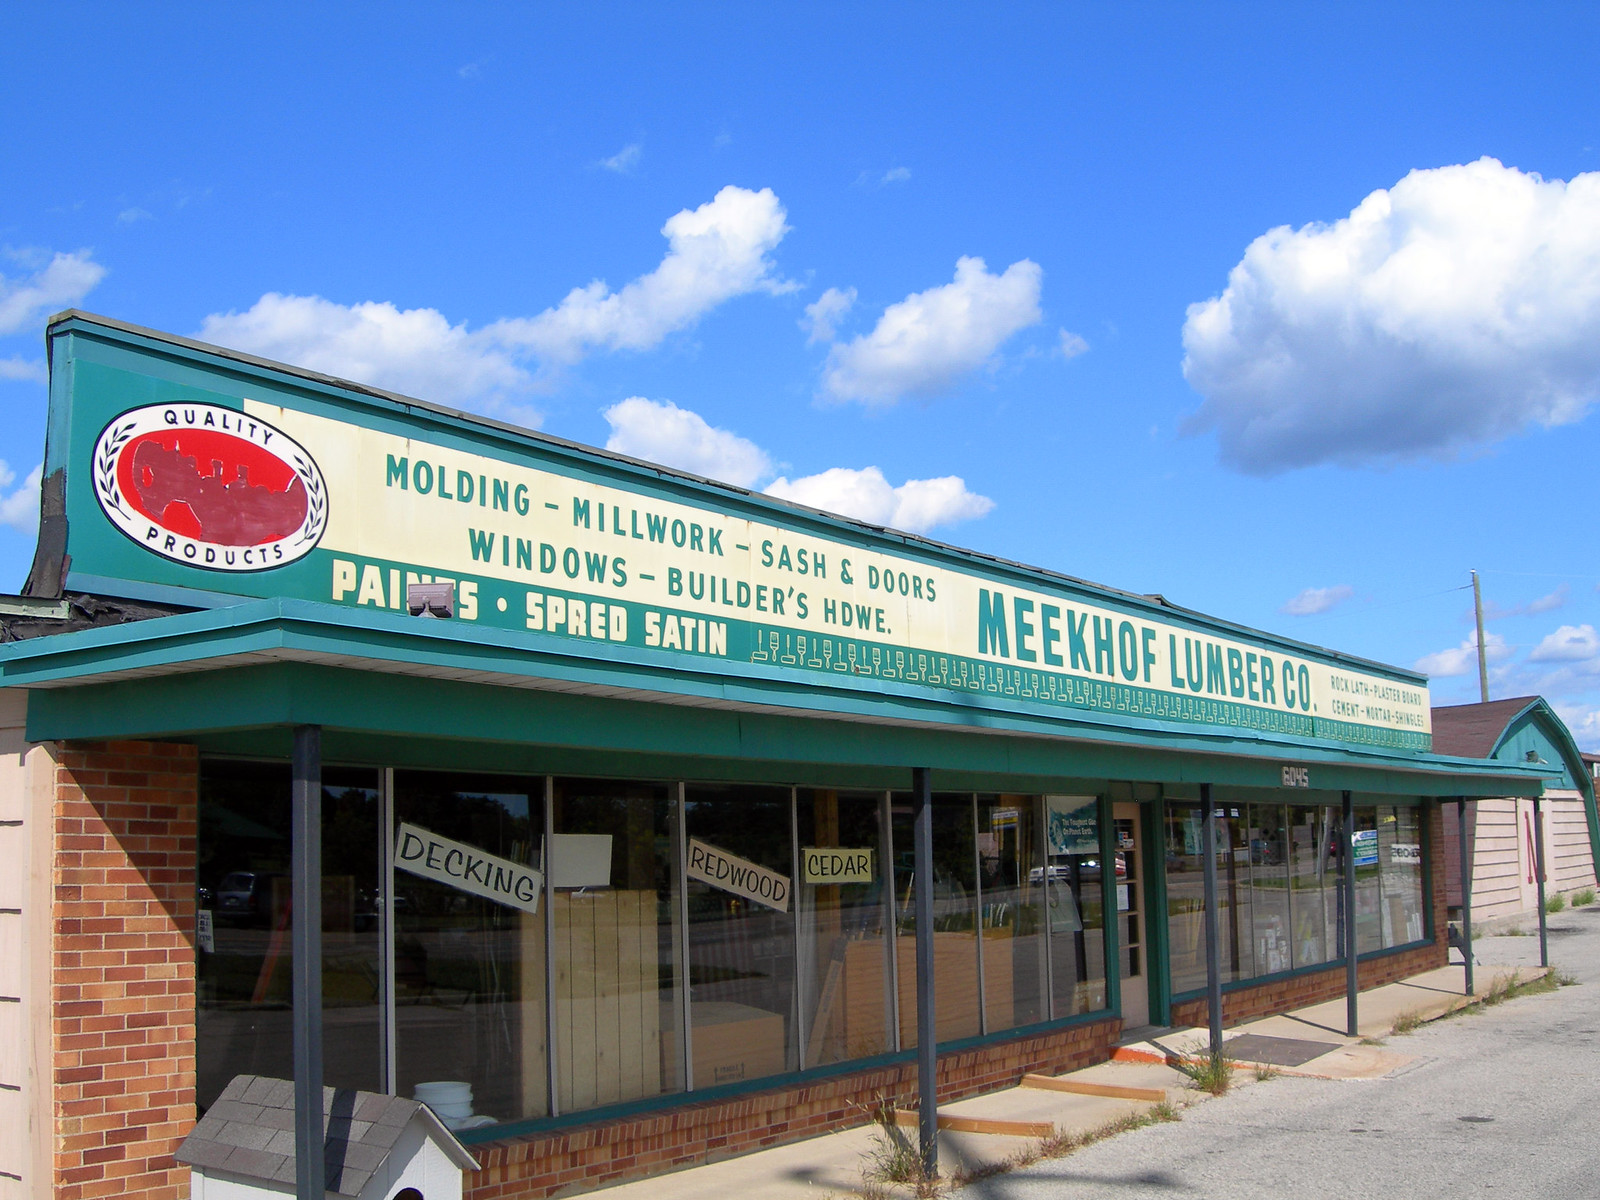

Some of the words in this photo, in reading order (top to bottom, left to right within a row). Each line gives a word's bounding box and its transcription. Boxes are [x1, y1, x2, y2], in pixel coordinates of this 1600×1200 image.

[164, 409, 273, 445] QUALITY
[146, 526, 283, 566] PRODUCTS
[386, 454, 530, 516] MOLDING
[573, 497, 724, 556] MILLWORK
[761, 540, 827, 579] SASH
[840, 558, 855, 586] &
[868, 565, 937, 602] DOORS
[331, 558, 479, 621] PAIS
[525, 591, 628, 643] SPRED
[644, 611, 728, 657] SATIN
[468, 528, 628, 588] WINDOWS
[668, 567, 809, 619] BUILDER'S
[824, 598, 892, 635] HDWE.
[979, 588, 1156, 683] MEEKHOF
[1169, 634, 1275, 708] LUMBER
[1282, 660, 1317, 712] CO.
[1331, 675, 1350, 694] ROCK
[1351, 679, 1369, 697] LATH
[1374, 684, 1401, 705] PLASTER
[1402, 690, 1422, 706] BOARD
[1332, 699, 1360, 718] CEMENT
[1366, 705, 1391, 723] MORTAR
[400, 832, 535, 903] DECKING
[691, 848, 786, 903] REDWOOD
[808, 854, 869, 876] CEDAR
